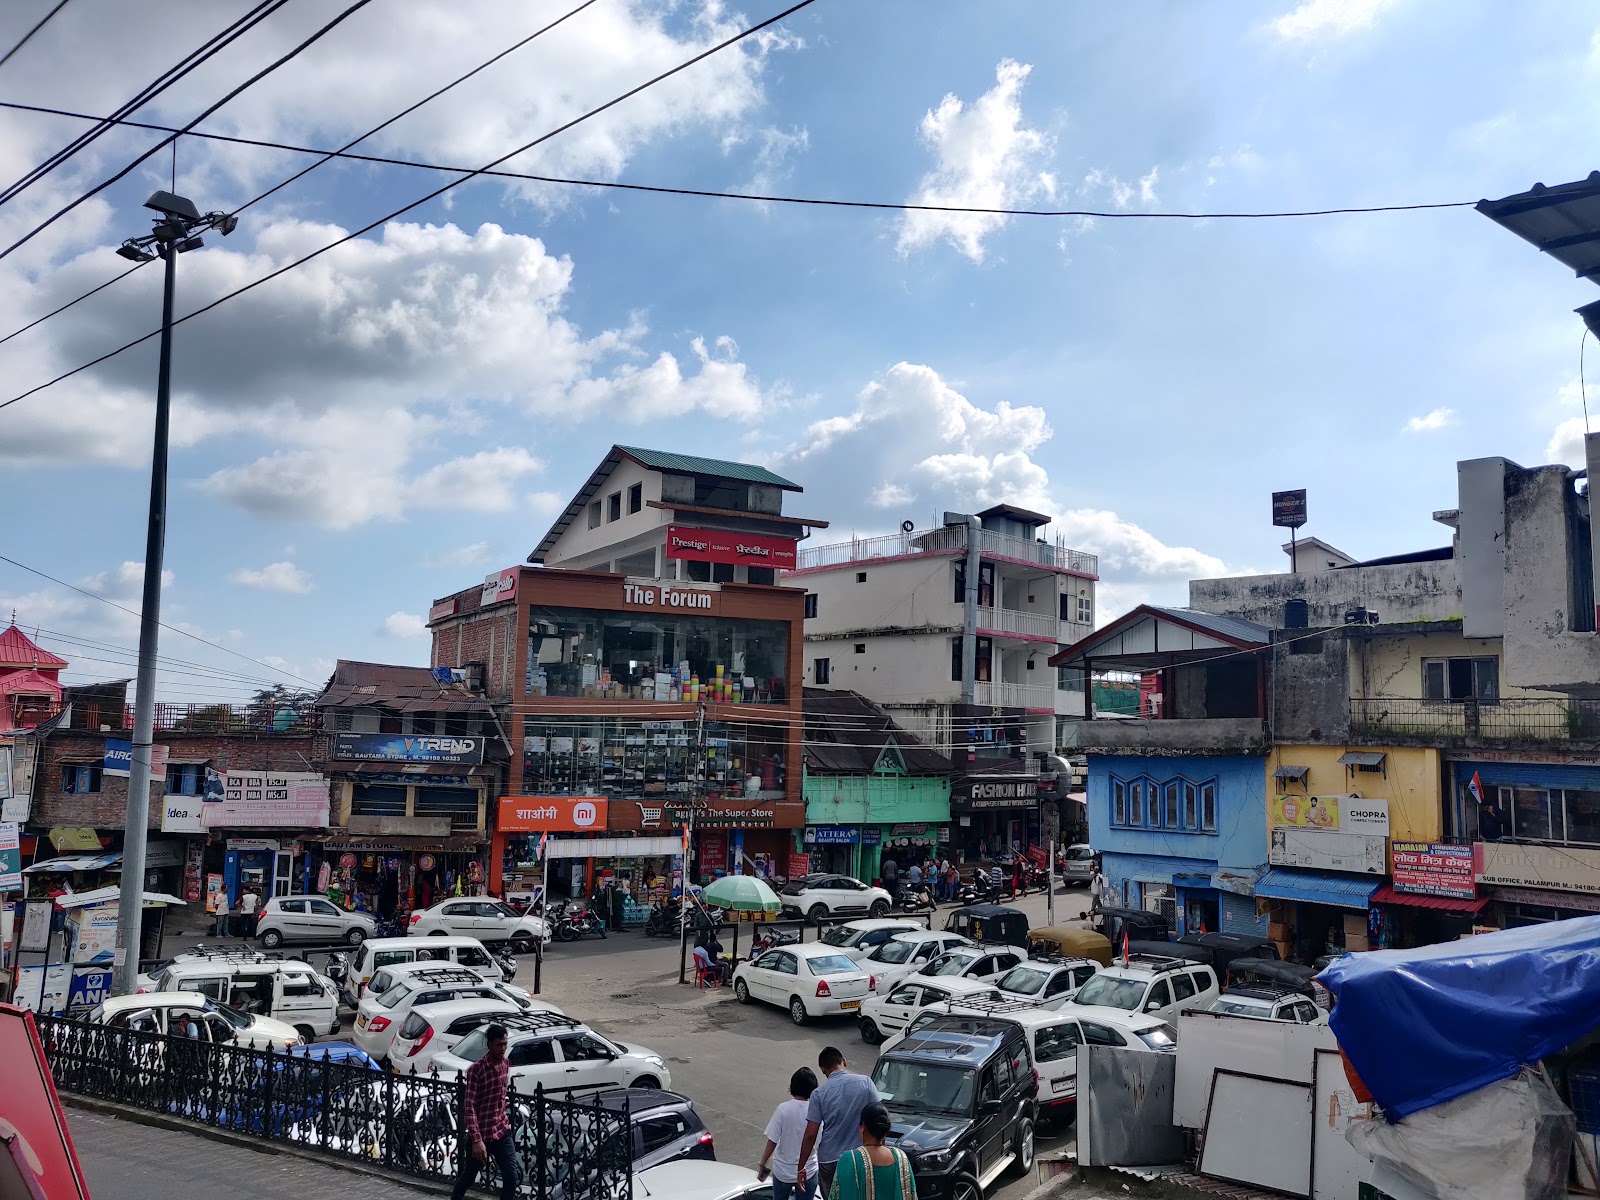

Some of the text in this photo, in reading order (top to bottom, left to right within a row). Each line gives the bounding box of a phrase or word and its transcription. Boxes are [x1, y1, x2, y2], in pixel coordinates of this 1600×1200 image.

[671, 536, 708, 550] Prestige
[623, 584, 712, 609] The Forum
[416, 737, 475, 751] TREND
[228, 778, 241, 786] BCA
[248, 778, 261, 786] BBA
[227, 791, 241, 799] MCA
[247, 791, 261, 799] MBA
[971, 782, 1037, 798] FASHION HUB
[516, 805, 558, 819] शाओमी
[708, 808, 724, 818] The
[725, 808, 749, 820] Super
[751, 808, 774, 817] Store
[1350, 810, 1386, 818] CHOPRA
[816, 830, 852, 838] ATTERA
[324, 841, 363, 849] GAUTAM
[1393, 843, 1429, 852] MAHAJAN
[1393, 852, 1418, 862] लोक
[1420, 854, 1443, 866] मित्र
[1497, 877, 1523, 885] OFFICE,
[1524, 879, 1561, 888] PALAMPUR
